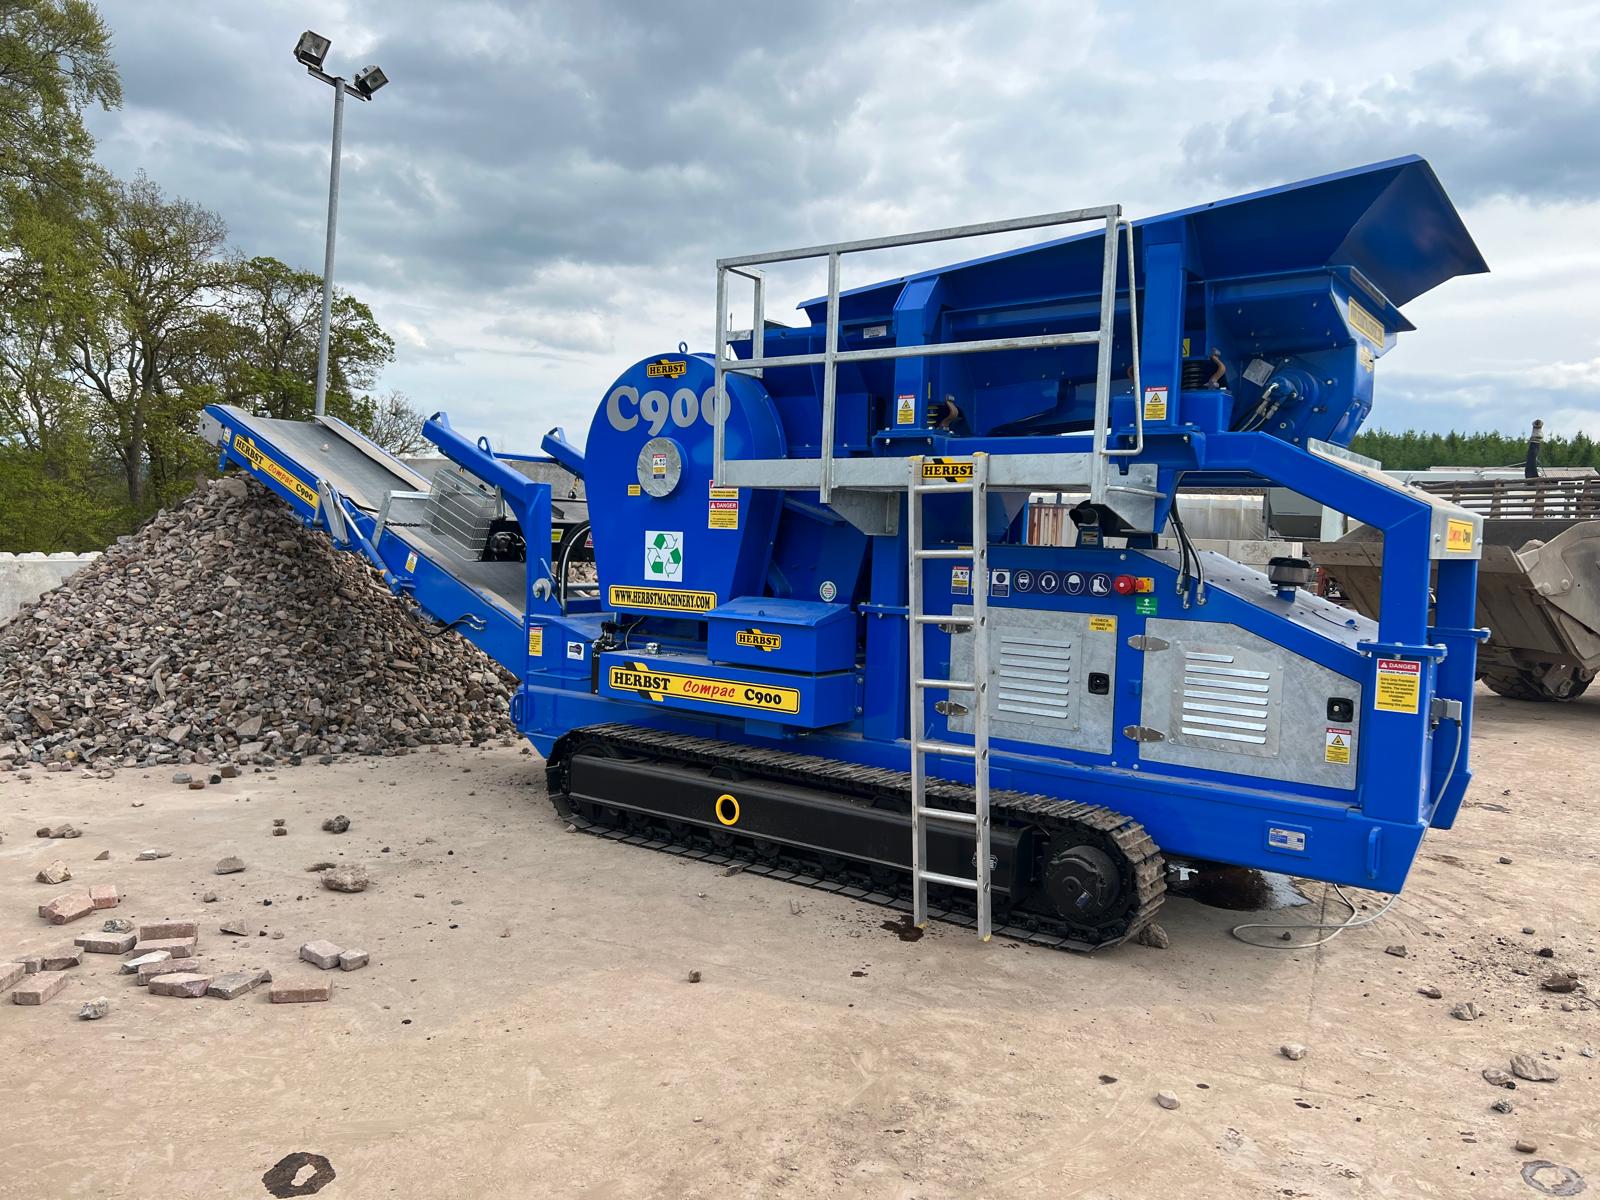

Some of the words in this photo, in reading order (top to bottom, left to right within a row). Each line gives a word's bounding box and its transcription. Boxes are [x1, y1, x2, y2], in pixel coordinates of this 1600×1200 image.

[650, 364, 684, 375] HERBST
[606, 385, 731, 437] C900
[235, 438, 265, 465] HERBST
[267, 463, 293, 486] Compac
[296, 483, 314, 501] C900
[924, 465, 974, 476] HERBST
[614, 589, 711, 610] WWW.HERBSTMACHINERY.COM
[739, 634, 779, 646] HERBST
[1389, 662, 1417, 670] DANGER
[614, 671, 671, 690] HERBST
[683, 680, 736, 698] Compac
[744, 688, 782, 705] C900
